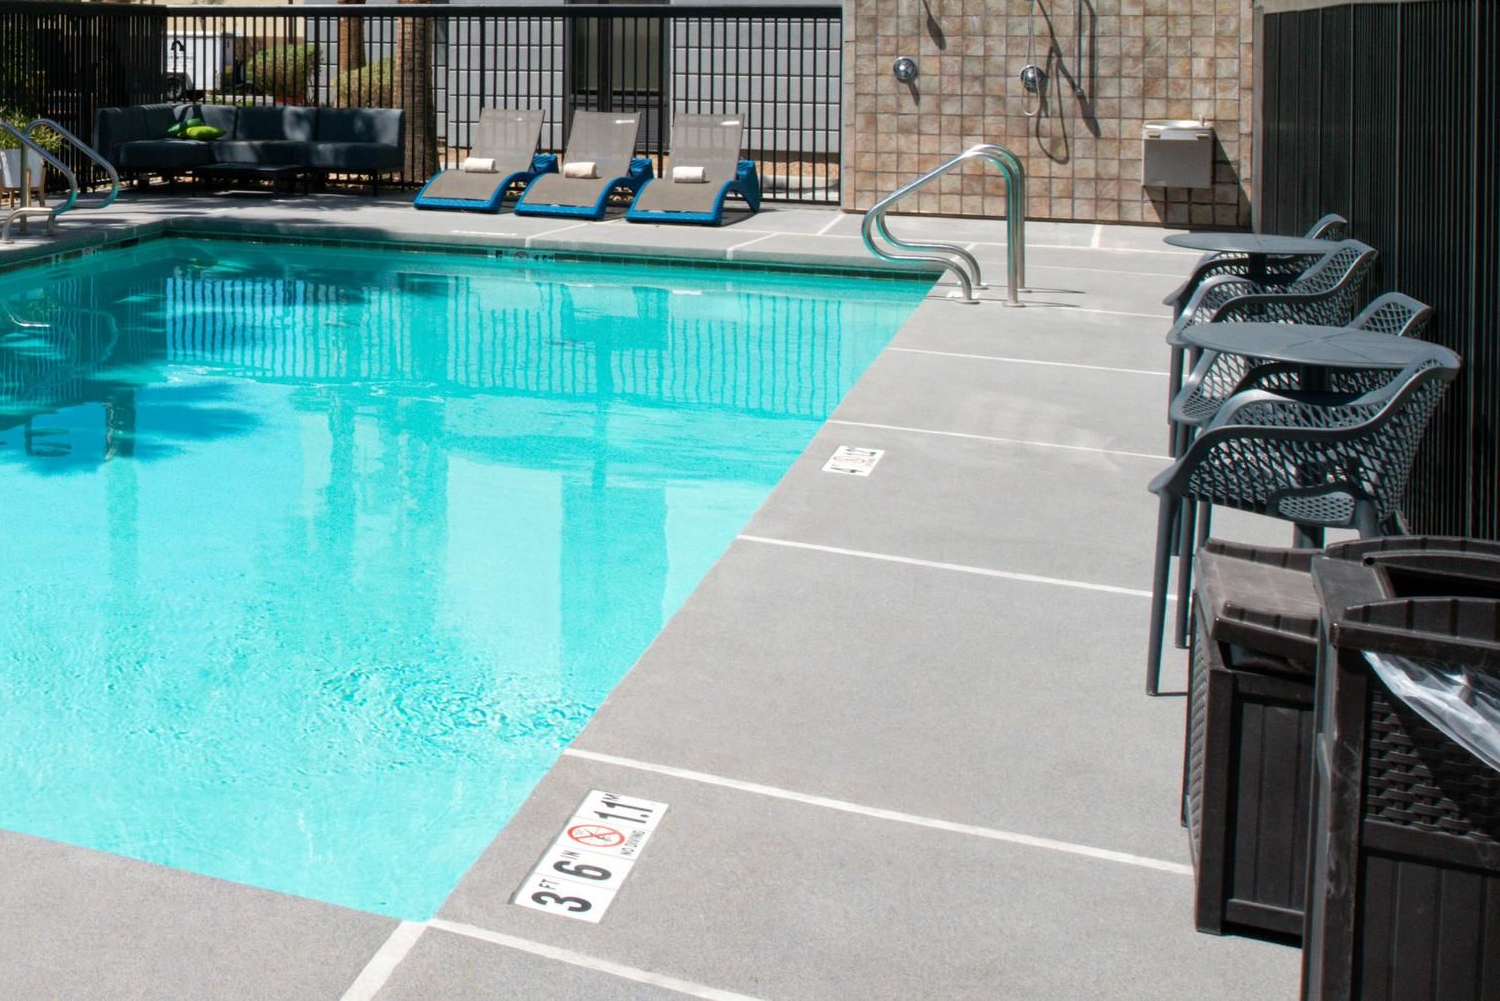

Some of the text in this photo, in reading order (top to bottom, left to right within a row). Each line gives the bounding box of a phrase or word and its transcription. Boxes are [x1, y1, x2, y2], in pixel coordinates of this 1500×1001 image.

[593, 800, 653, 824] 1.1
[531, 849, 612, 913] 3 FT 6 IN
